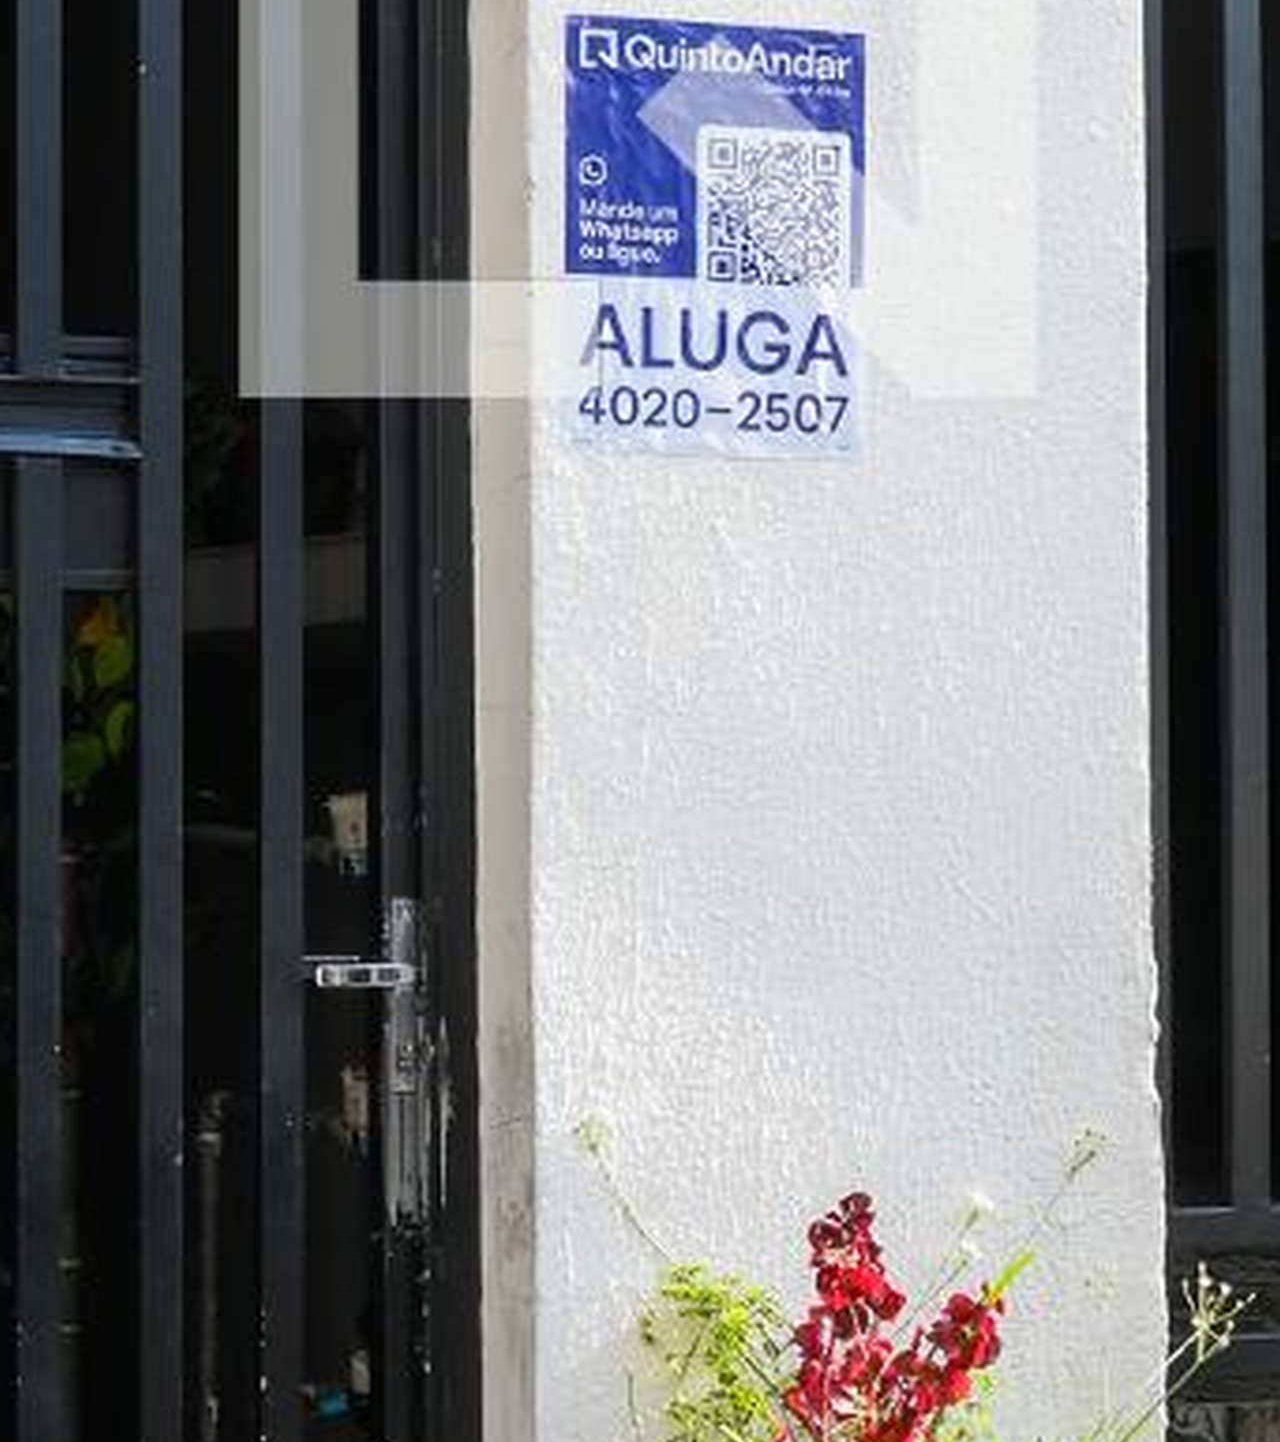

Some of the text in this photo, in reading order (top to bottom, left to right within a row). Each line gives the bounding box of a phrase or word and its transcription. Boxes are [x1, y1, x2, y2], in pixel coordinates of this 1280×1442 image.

[624, 33, 852, 81] QuintoAndar
[579, 198, 645, 220] Mande
[579, 243, 604, 260] ou
[580, 303, 849, 378] ALUGA
[579, 386, 850, 433] 4020-2507
